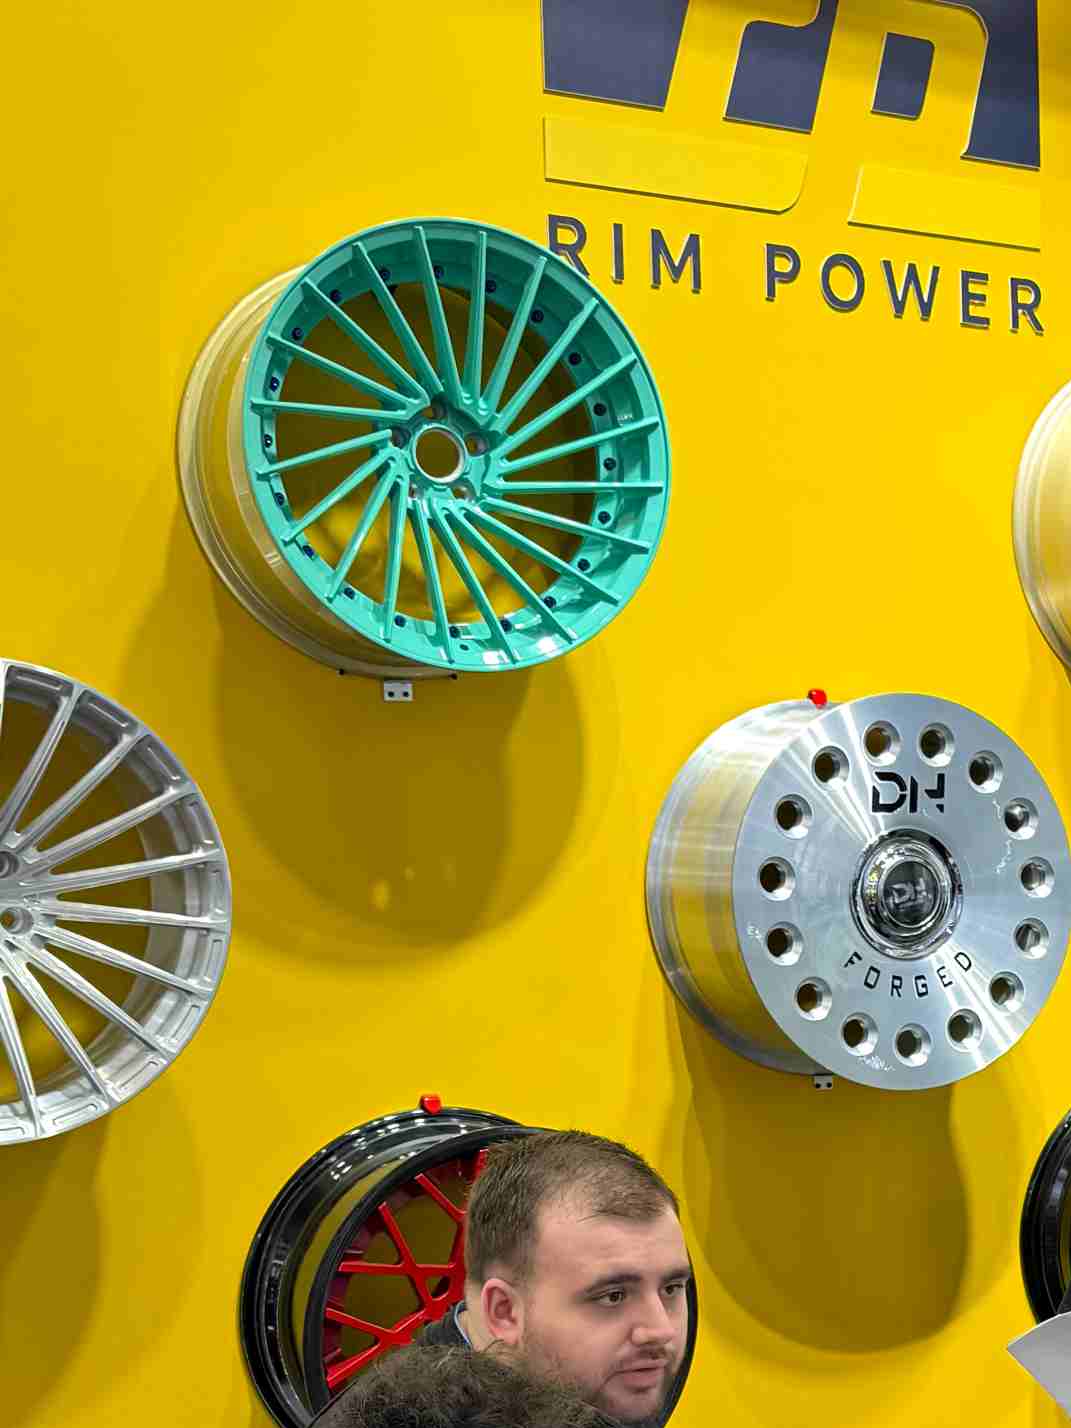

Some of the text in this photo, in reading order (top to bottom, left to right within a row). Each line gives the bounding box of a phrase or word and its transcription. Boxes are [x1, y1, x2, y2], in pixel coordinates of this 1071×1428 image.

[546, 213, 1045, 336] RIM POWER
[871, 771, 946, 814] DH
[844, 951, 973, 999] FORGED
